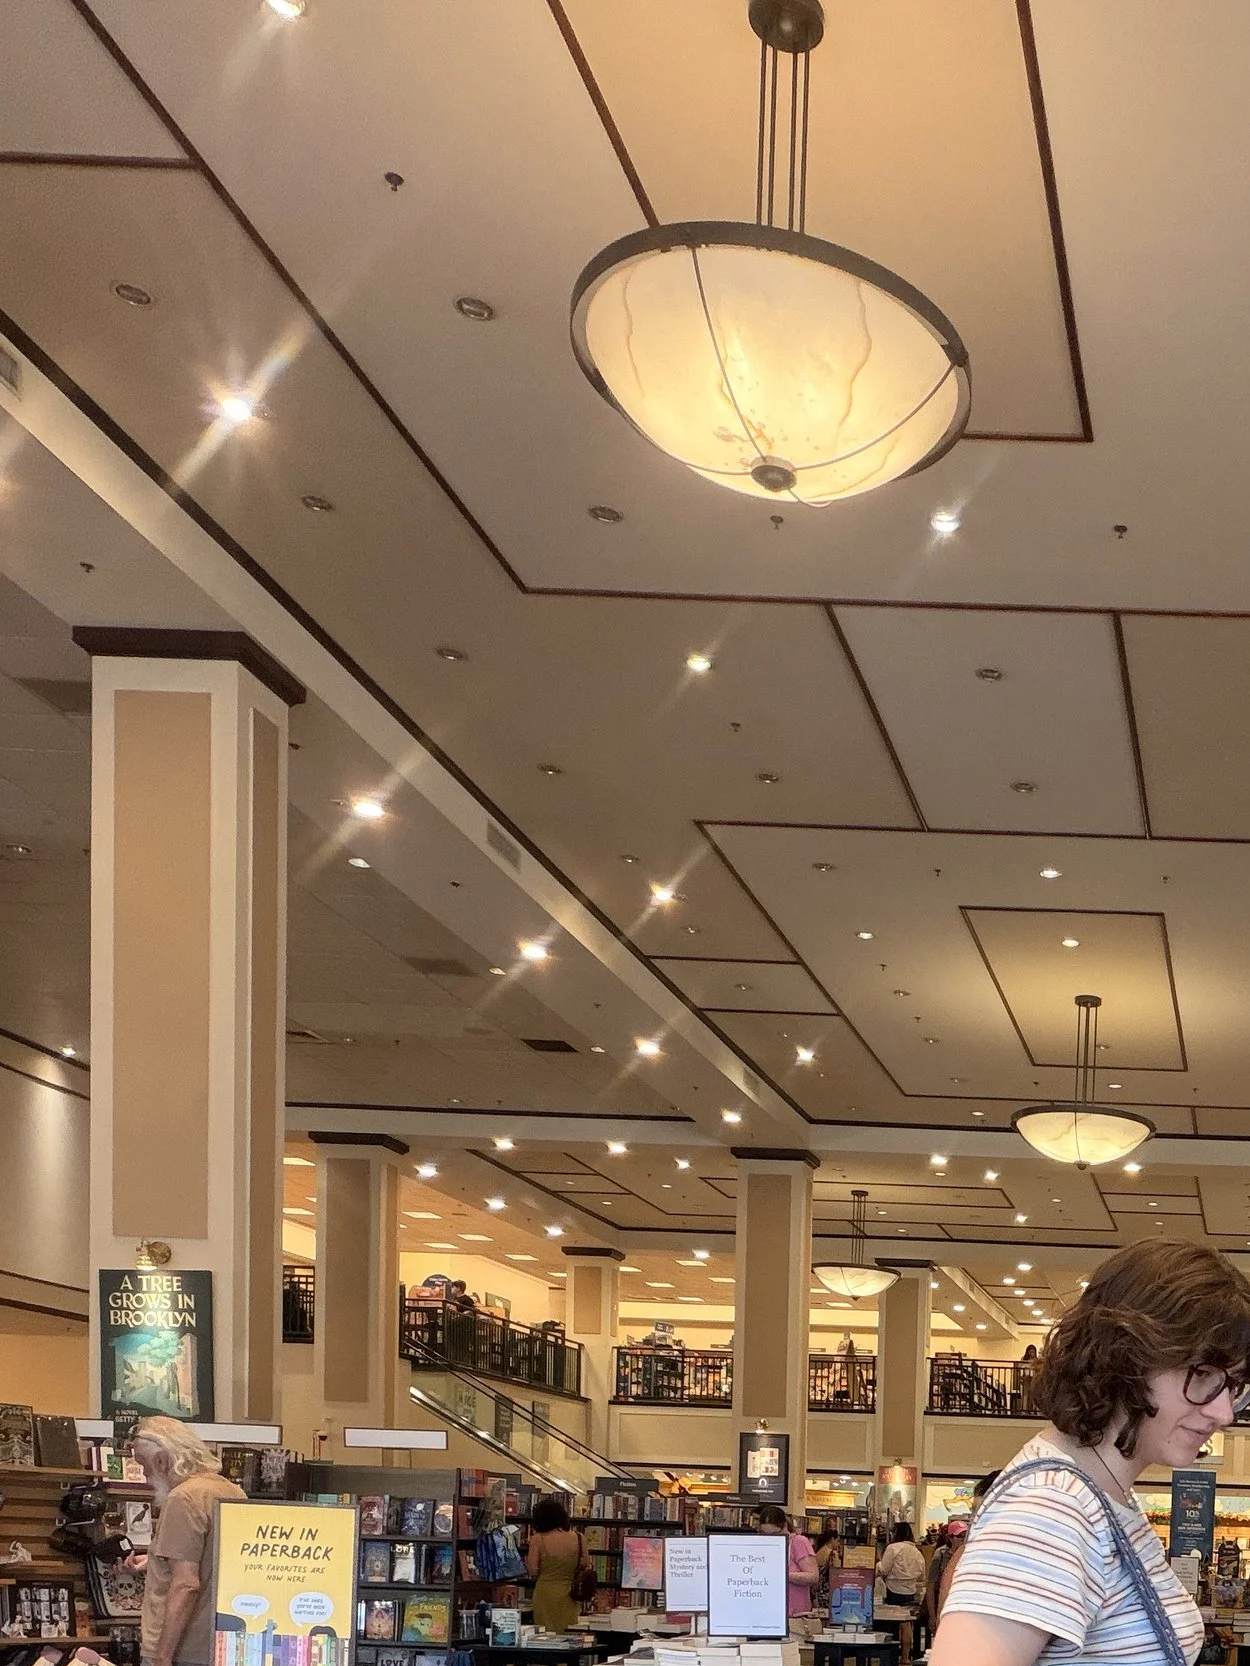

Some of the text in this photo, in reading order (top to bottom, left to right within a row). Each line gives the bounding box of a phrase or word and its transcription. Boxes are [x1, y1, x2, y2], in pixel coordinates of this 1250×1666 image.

[120, 1275, 182, 1292] A TREE
[109, 1292, 195, 1310] GROWS IN
[110, 1310, 197, 1329] BROOKLYN
[256, 1525, 319, 1541] NEW IN
[240, 1542, 334, 1561] PAPERBACK
[730, 1554, 765, 1563] The Best
[244, 1563, 326, 1574] YOUR FAVORITES ARE
[743, 1566, 753, 1575] Of
[287, 1575, 306, 1583] HERE
[727, 1577, 769, 1588] Paperback
[734, 1589, 762, 1598] Fiction
